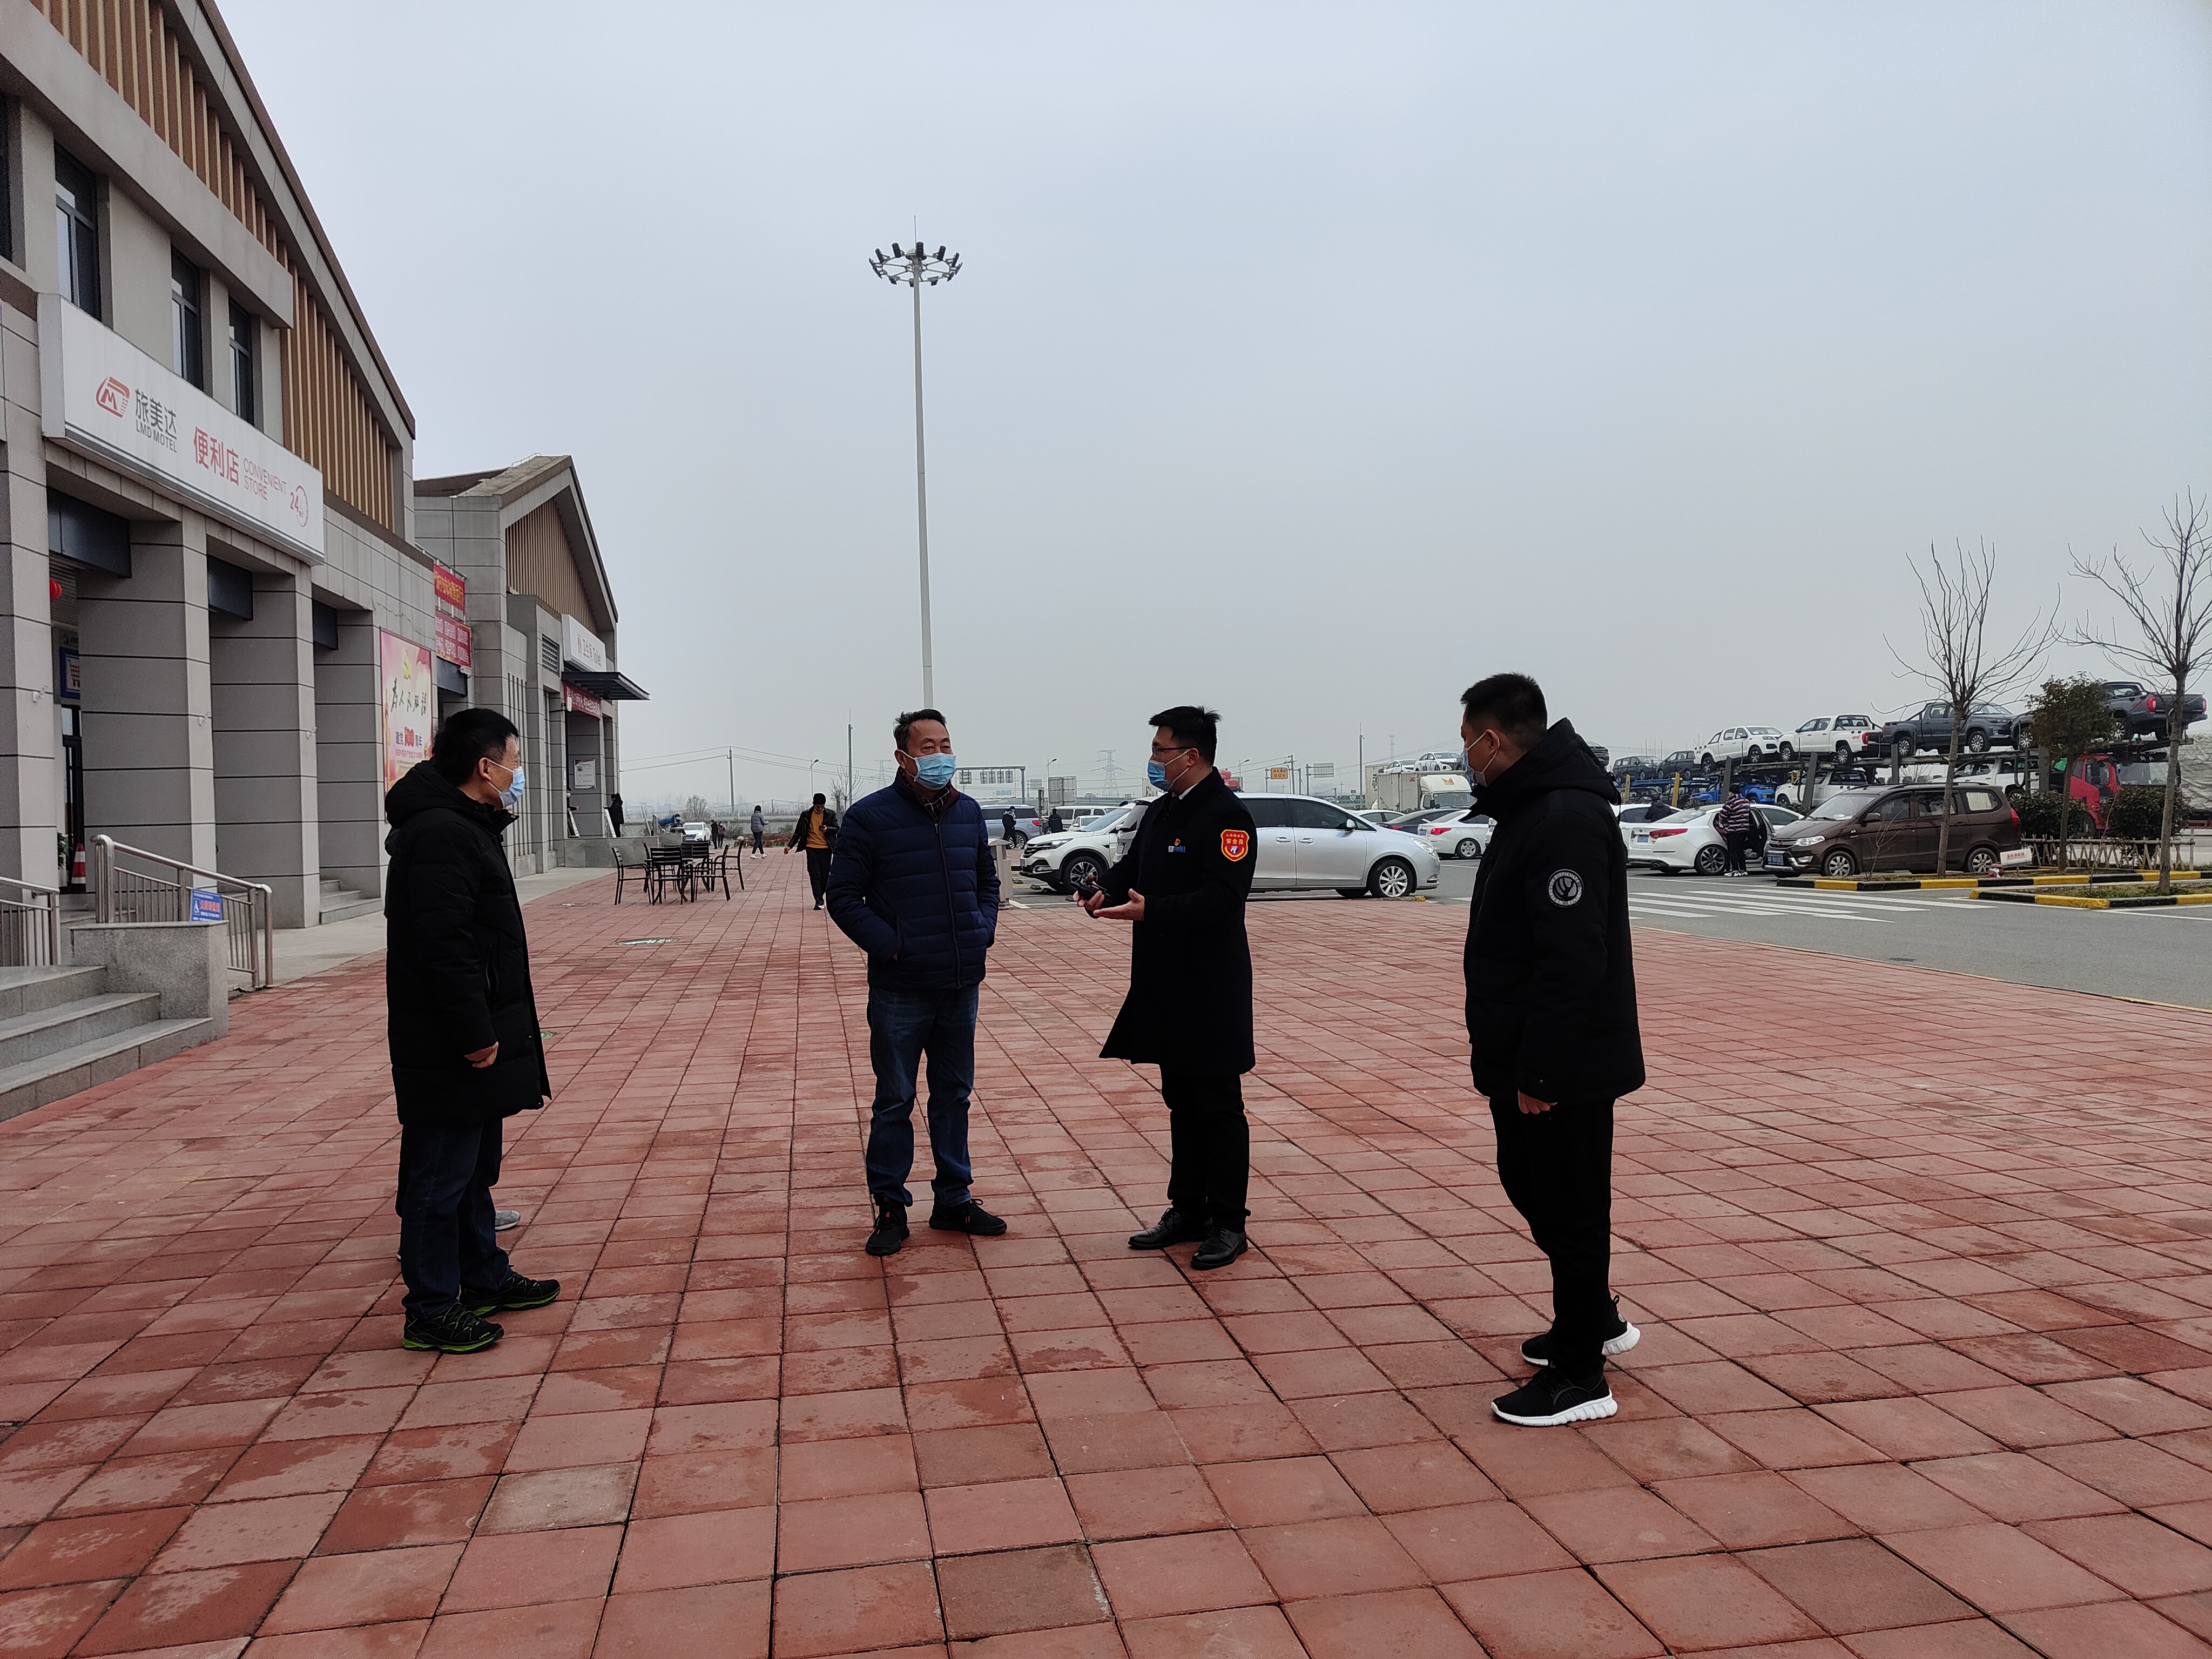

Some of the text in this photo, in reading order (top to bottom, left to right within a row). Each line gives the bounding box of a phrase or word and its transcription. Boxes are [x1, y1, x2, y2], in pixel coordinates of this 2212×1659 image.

[135, 388, 177, 440] 旅美达
[136, 419, 177, 453] LMD MOTEL
[194, 426, 239, 485] 便利店
[244, 458, 287, 495] CONVENIENT
[245, 475, 268, 501] STORE
